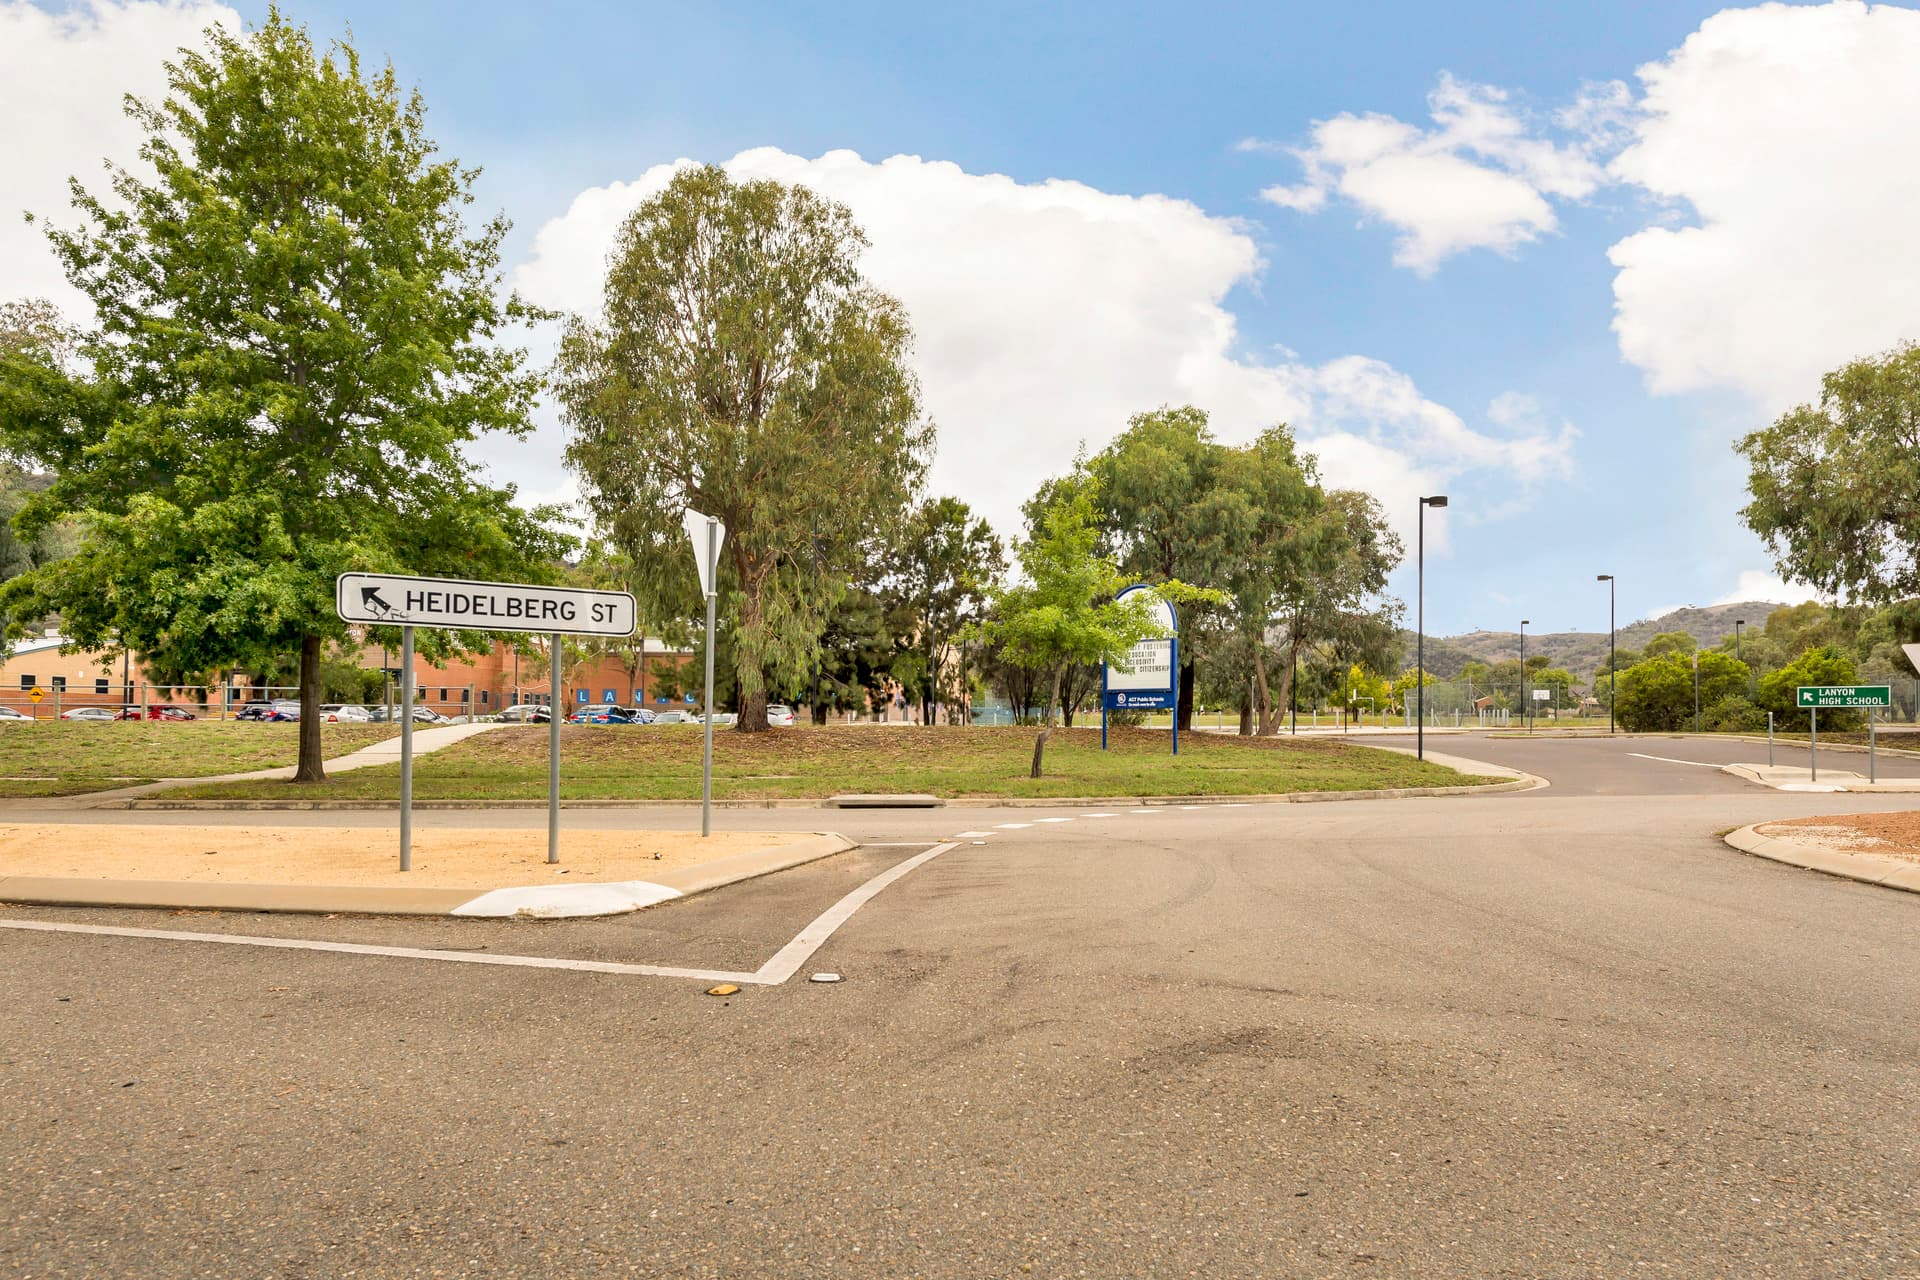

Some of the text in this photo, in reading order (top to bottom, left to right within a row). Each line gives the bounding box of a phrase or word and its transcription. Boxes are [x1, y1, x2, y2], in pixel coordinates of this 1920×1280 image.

[406, 590, 618, 623] HEIDELBERG ST
[1140, 665, 1169, 673] CITIZENSHIP
[1819, 688, 1855, 696] LANYON
[1819, 696, 1885, 705] HIGH SCHOOL
